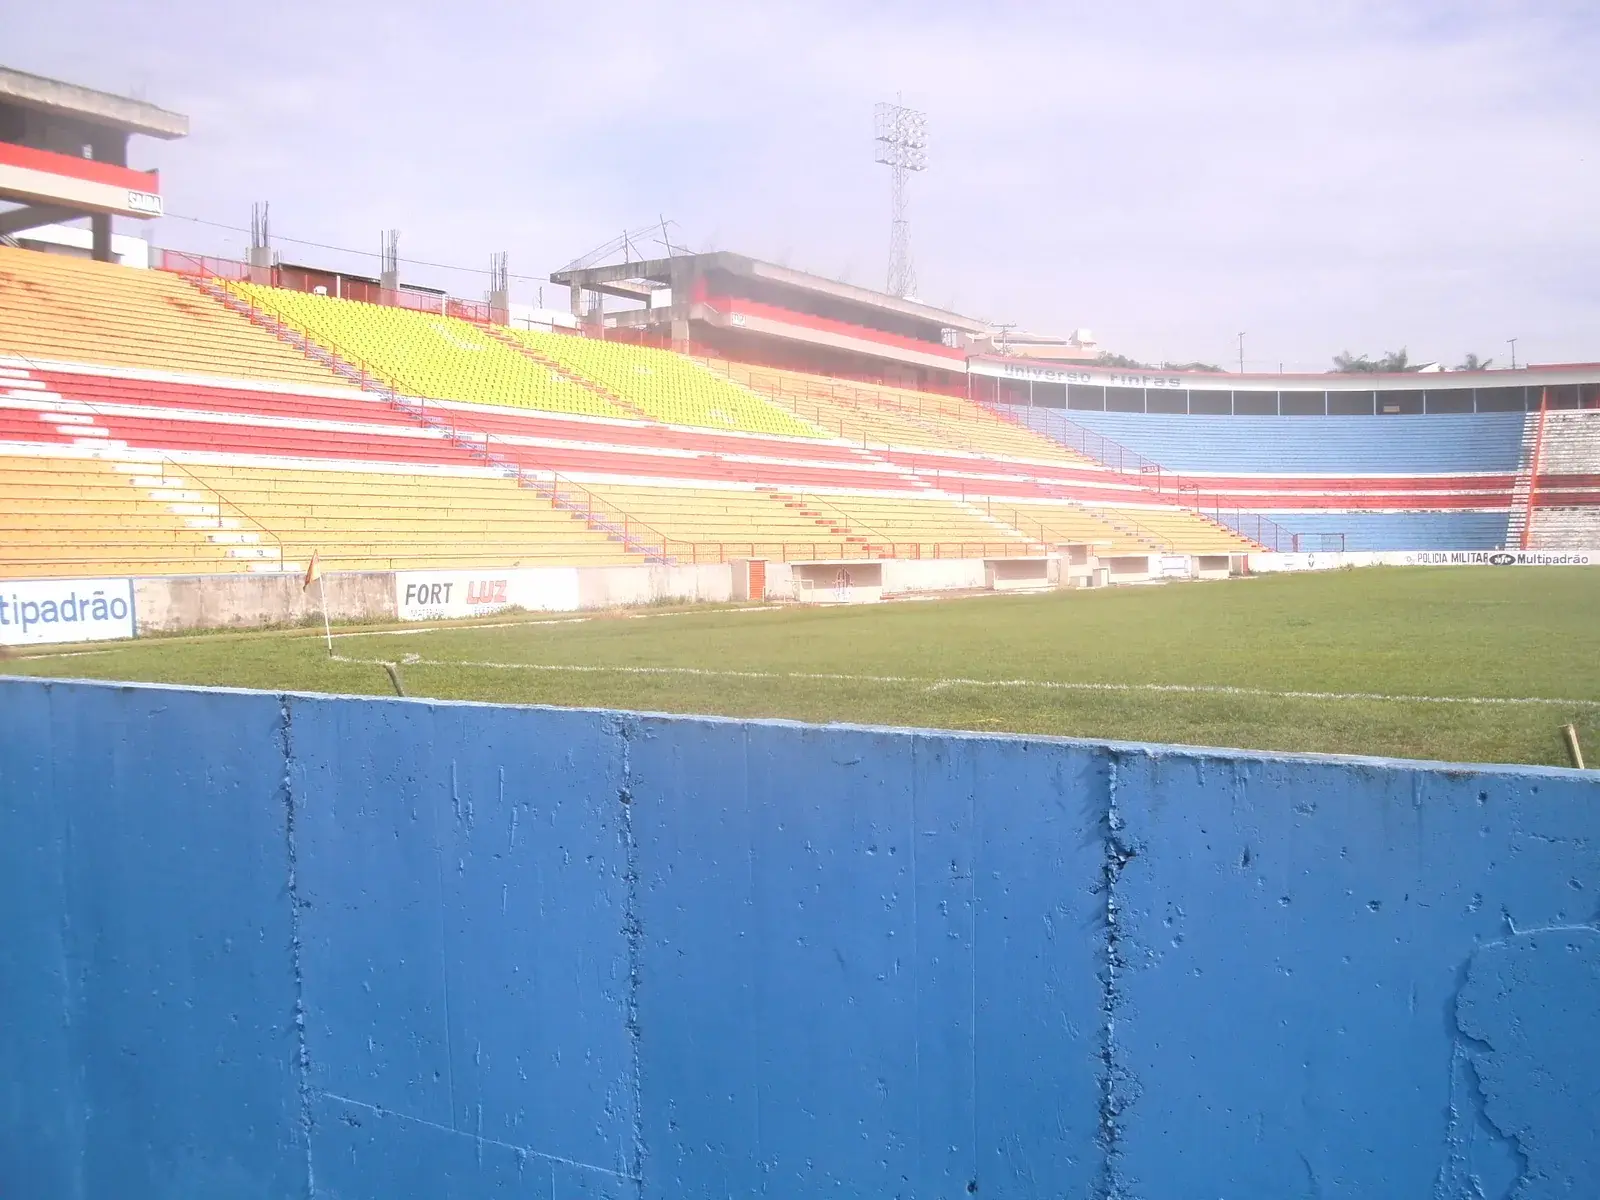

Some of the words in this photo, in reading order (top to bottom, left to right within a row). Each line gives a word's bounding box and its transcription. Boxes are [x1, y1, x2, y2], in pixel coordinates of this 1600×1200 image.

[1451, 552, 1489, 565] MILITAR
[1517, 553, 1589, 566] Multipadrão
[405, 582, 453, 606] FORT
[466, 579, 507, 605] LUZ
